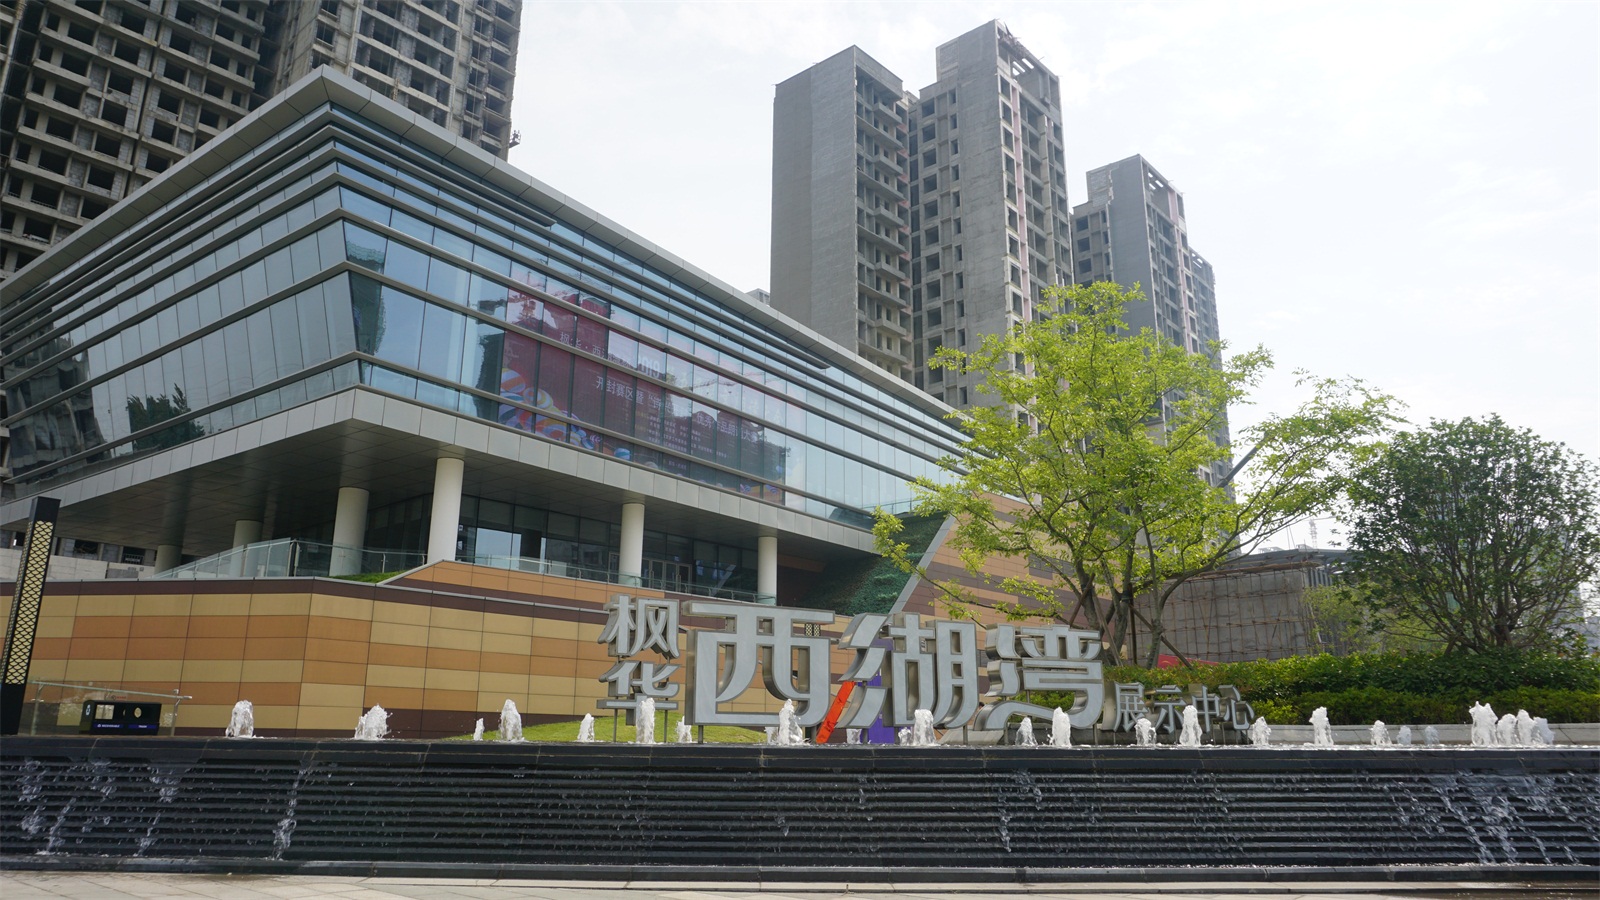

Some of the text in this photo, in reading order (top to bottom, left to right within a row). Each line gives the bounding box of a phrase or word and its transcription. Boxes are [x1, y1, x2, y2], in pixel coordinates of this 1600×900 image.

[598, 594, 680, 710] 枫华
[681, 600, 1105, 731] 西湖湾
[1113, 681, 1255, 734] 展示中心
